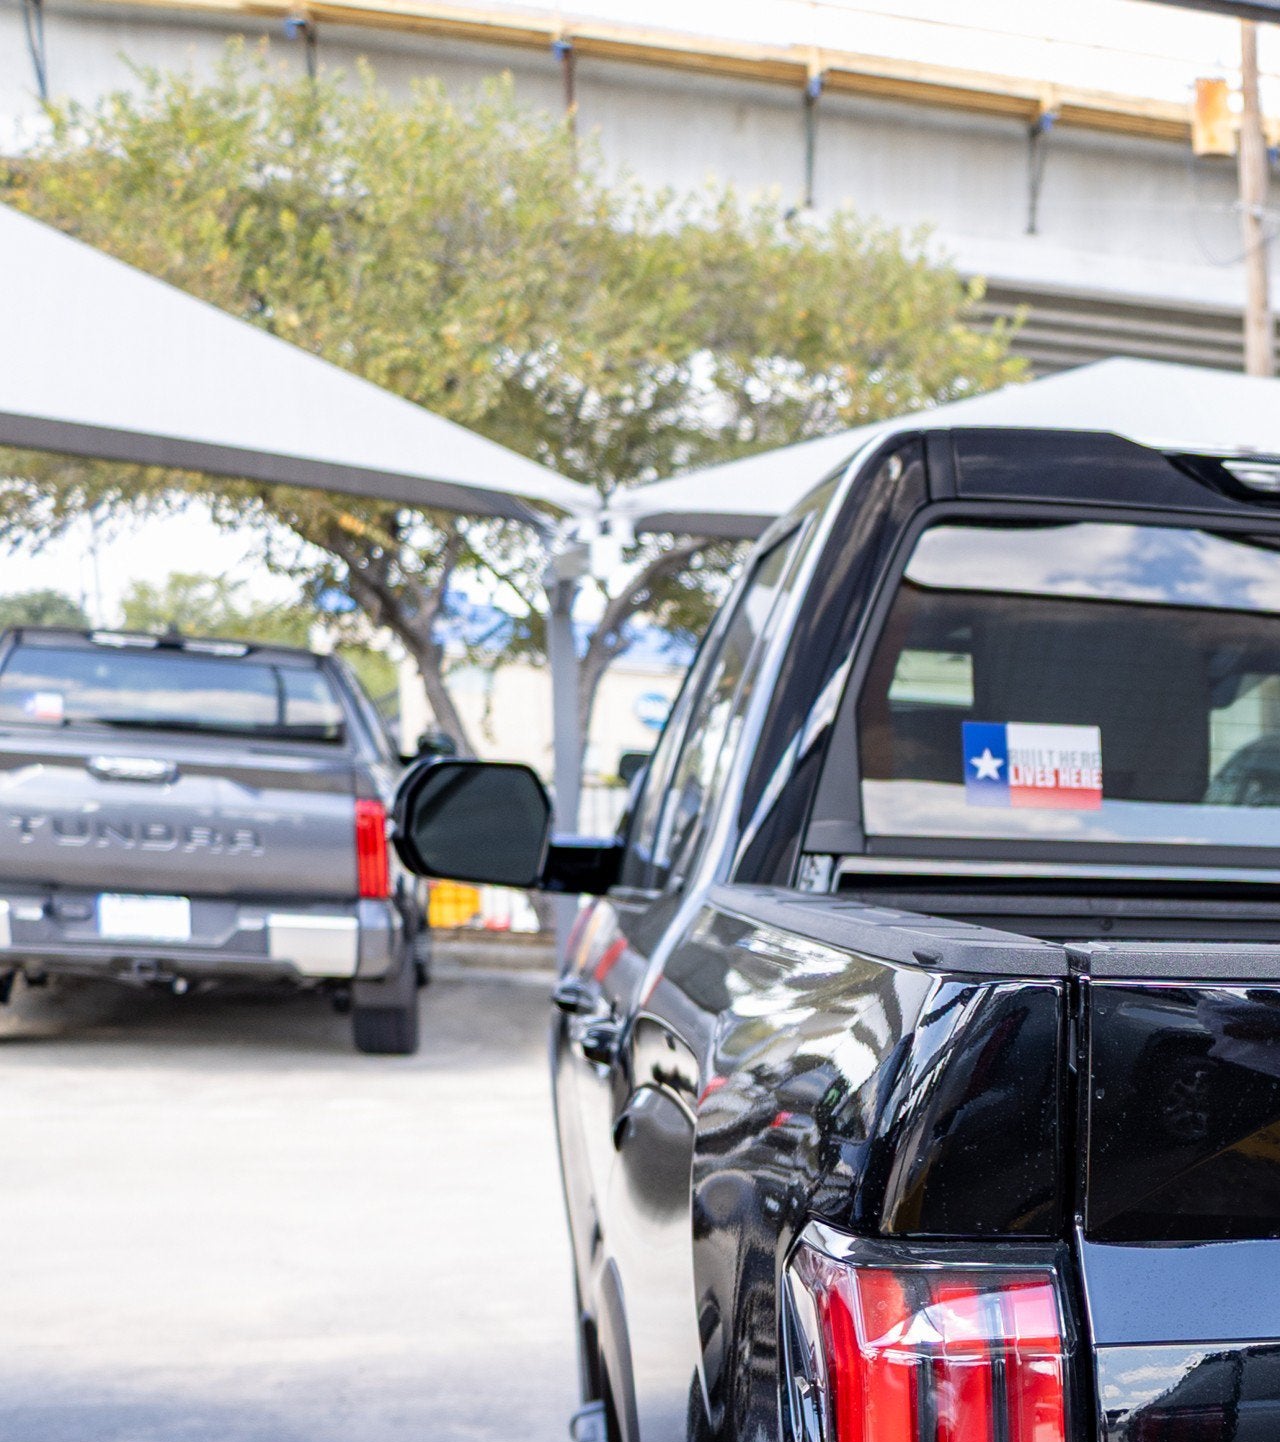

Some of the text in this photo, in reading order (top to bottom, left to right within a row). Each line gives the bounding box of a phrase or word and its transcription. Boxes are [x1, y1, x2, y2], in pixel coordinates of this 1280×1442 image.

[1009, 765, 1102, 789] LIVES HERE
[9, 816, 265, 857] TUNDRA
